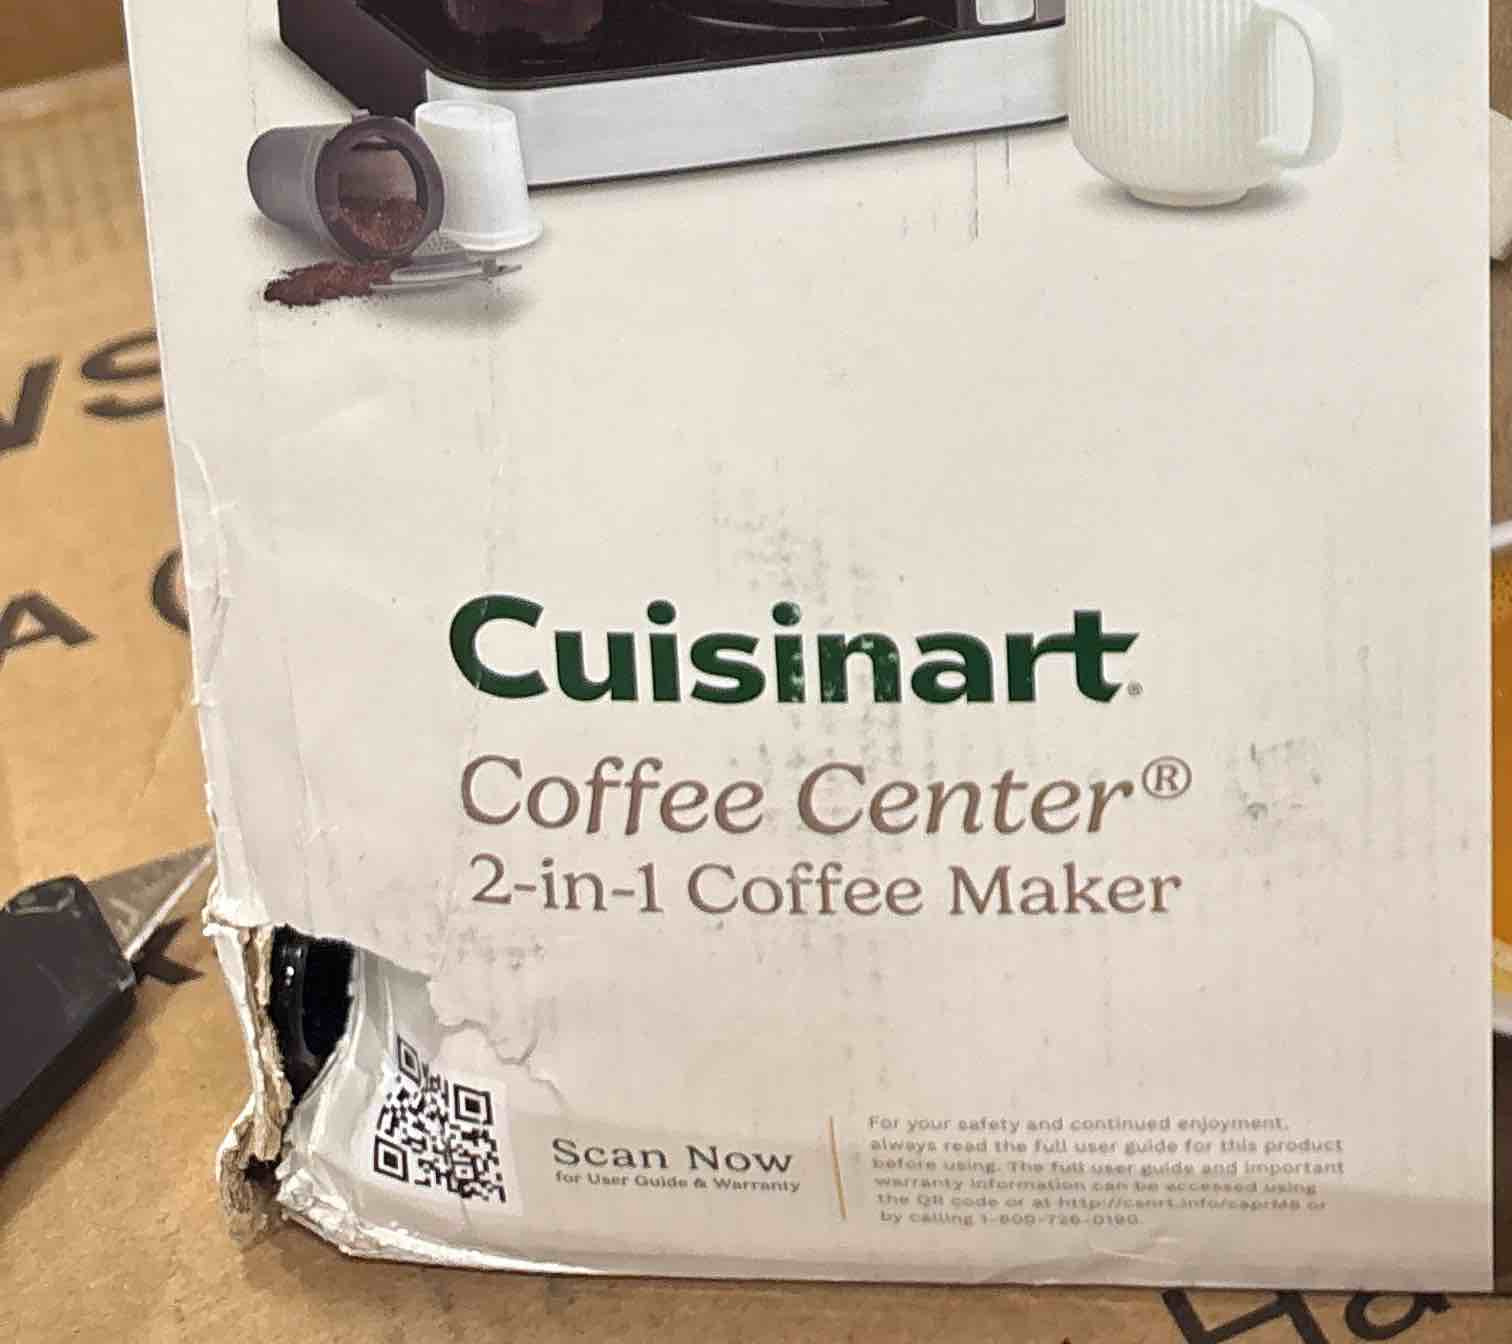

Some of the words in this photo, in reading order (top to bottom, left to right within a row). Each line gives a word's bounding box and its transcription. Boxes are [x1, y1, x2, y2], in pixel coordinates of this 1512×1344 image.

[460, 755, 766, 835] Coffee
[469, 852, 660, 913] 2-in-1
[687, 862, 923, 915] Coffee
[948, 864, 1183, 915] Maker
[869, 1116, 899, 1130] For
[906, 1118, 951, 1133] your
[958, 1117, 1020, 1133] safety
[1026, 1117, 1063, 1131] and
[1070, 1117, 1171, 1131] continued
[552, 1138, 668, 1169] Scan
[686, 1145, 793, 1173] Now
[871, 1138, 937, 1154] always
[944, 1139, 988, 1153] read
[994, 1139, 1028, 1153] the
[1034, 1138, 1068, 1153] full
[1074, 1140, 1117, 1154] user
[1124, 1139, 1178, 1156] guide
[1184, 1139, 1213, 1153] for
[1220, 1137, 1257, 1153] this
[1264, 1139, 1344, 1155] product
[872, 1158, 937, 1171] before
[944, 1159, 1001, 1174] using.
[1007, 1160, 1043, 1173] The
[1051, 1161, 1085, 1174] full
[1090, 1163, 1133, 1176] user
[1140, 1162, 1194, 1177] guide
[1201, 1161, 1238, 1175] and
[1244, 1161, 1345, 1176] important
[555, 1170, 580, 1184] for
[586, 1172, 629, 1187] User
[634, 1174, 688, 1189] Guide
[693, 1177, 708, 1189] &
[713, 1177, 800, 1193] Warranty
[873, 1176, 963, 1191] warranty
[970, 1177, 1086, 1192] information
[1092, 1181, 1129, 1193] can
[1165, 1180, 1258, 1193] accessed
[1263, 1181, 1318, 1196] using
[877, 1193, 910, 1205] the
[917, 1193, 944, 1207] QR
[950, 1195, 1000, 1209] code
[1004, 1197, 1025, 1209] or
[1031, 1196, 1052, 1209] at
[1306, 1199, 1327, 1211] or
[880, 1210, 902, 1225] by
[908, 1212, 975, 1227] calling
